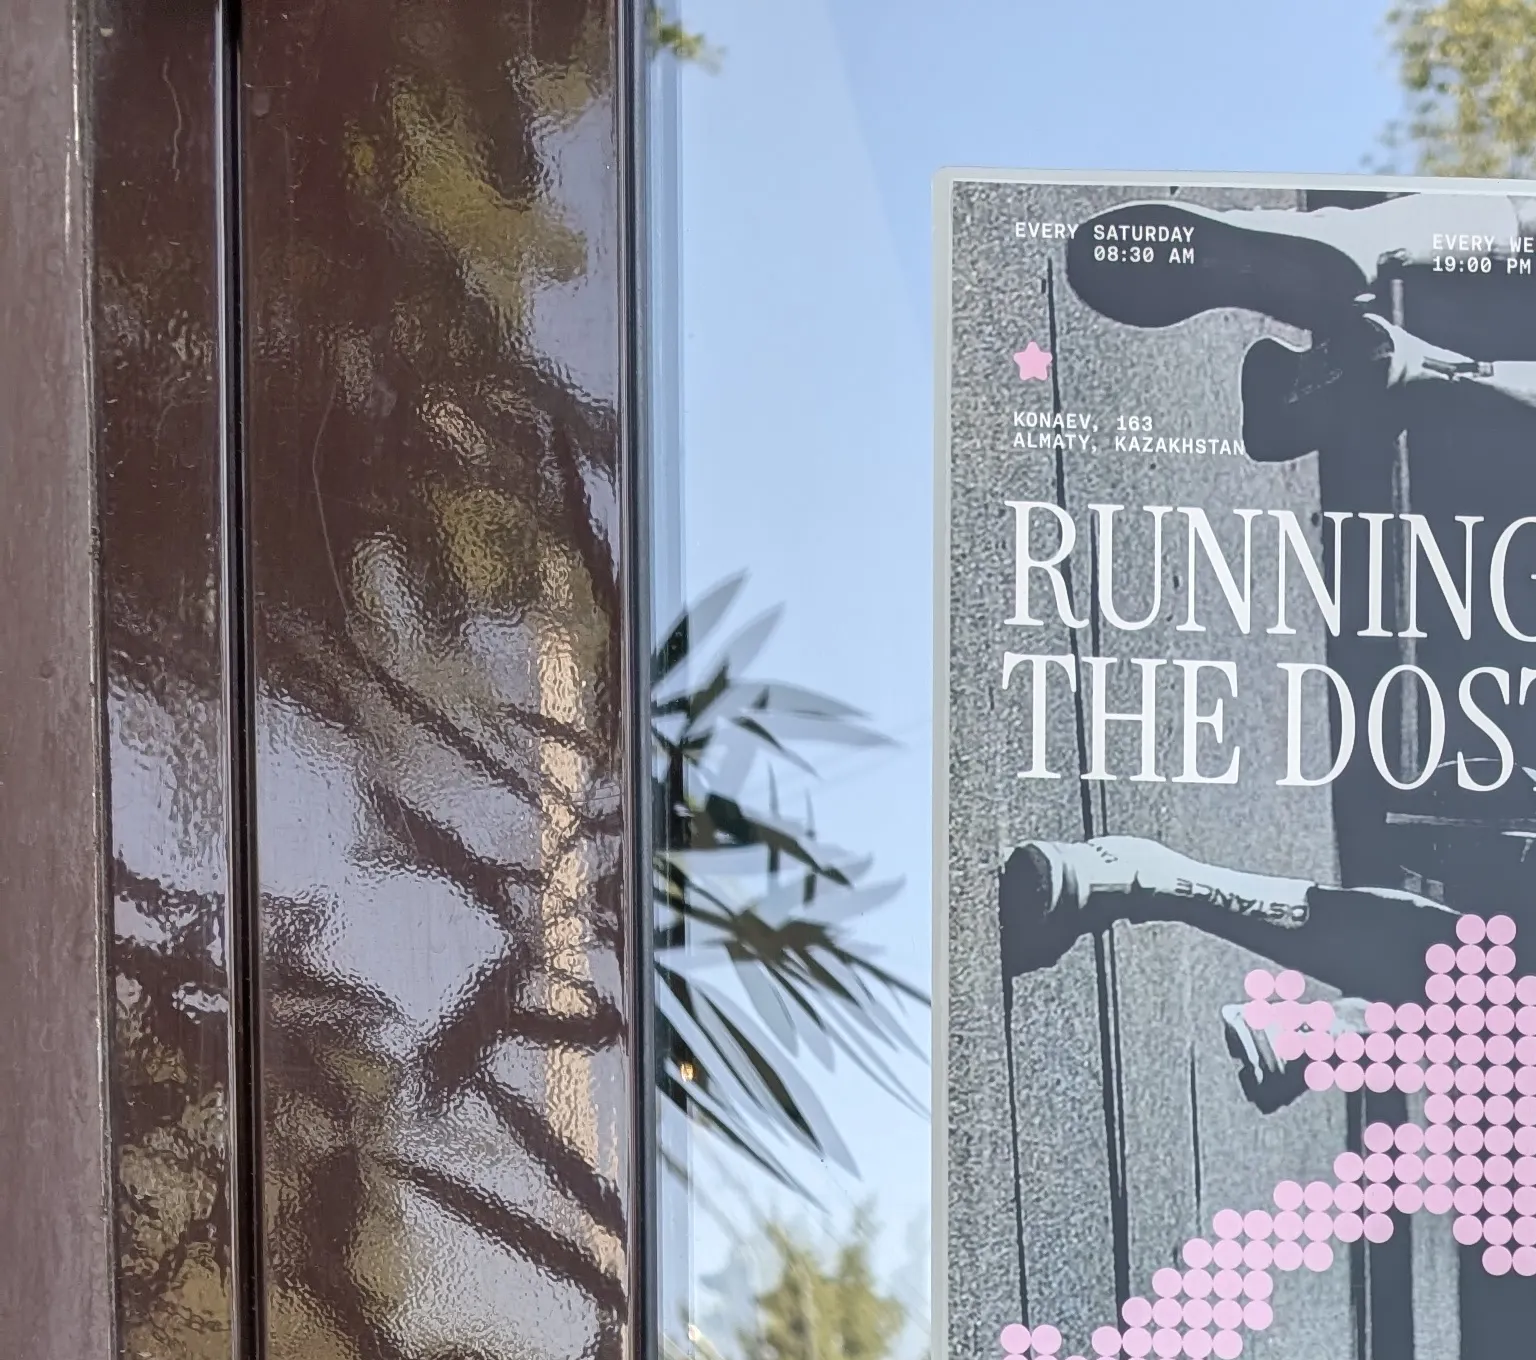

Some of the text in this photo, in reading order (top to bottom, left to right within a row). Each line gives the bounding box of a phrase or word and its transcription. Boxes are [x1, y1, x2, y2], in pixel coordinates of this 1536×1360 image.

[1014, 222, 1196, 243] EVERY SATURDAY
[1432, 233, 1496, 253] EVERY
[1093, 245, 1196, 264] 08:30 AM
[1432, 255, 1533, 275] 19:00 PM
[1013, 411, 1153, 432] KONAEV, 163
[1012, 433, 1245, 455] ALMATY, KAZAKHSTAN
[1001, 651, 1239, 784] THE
